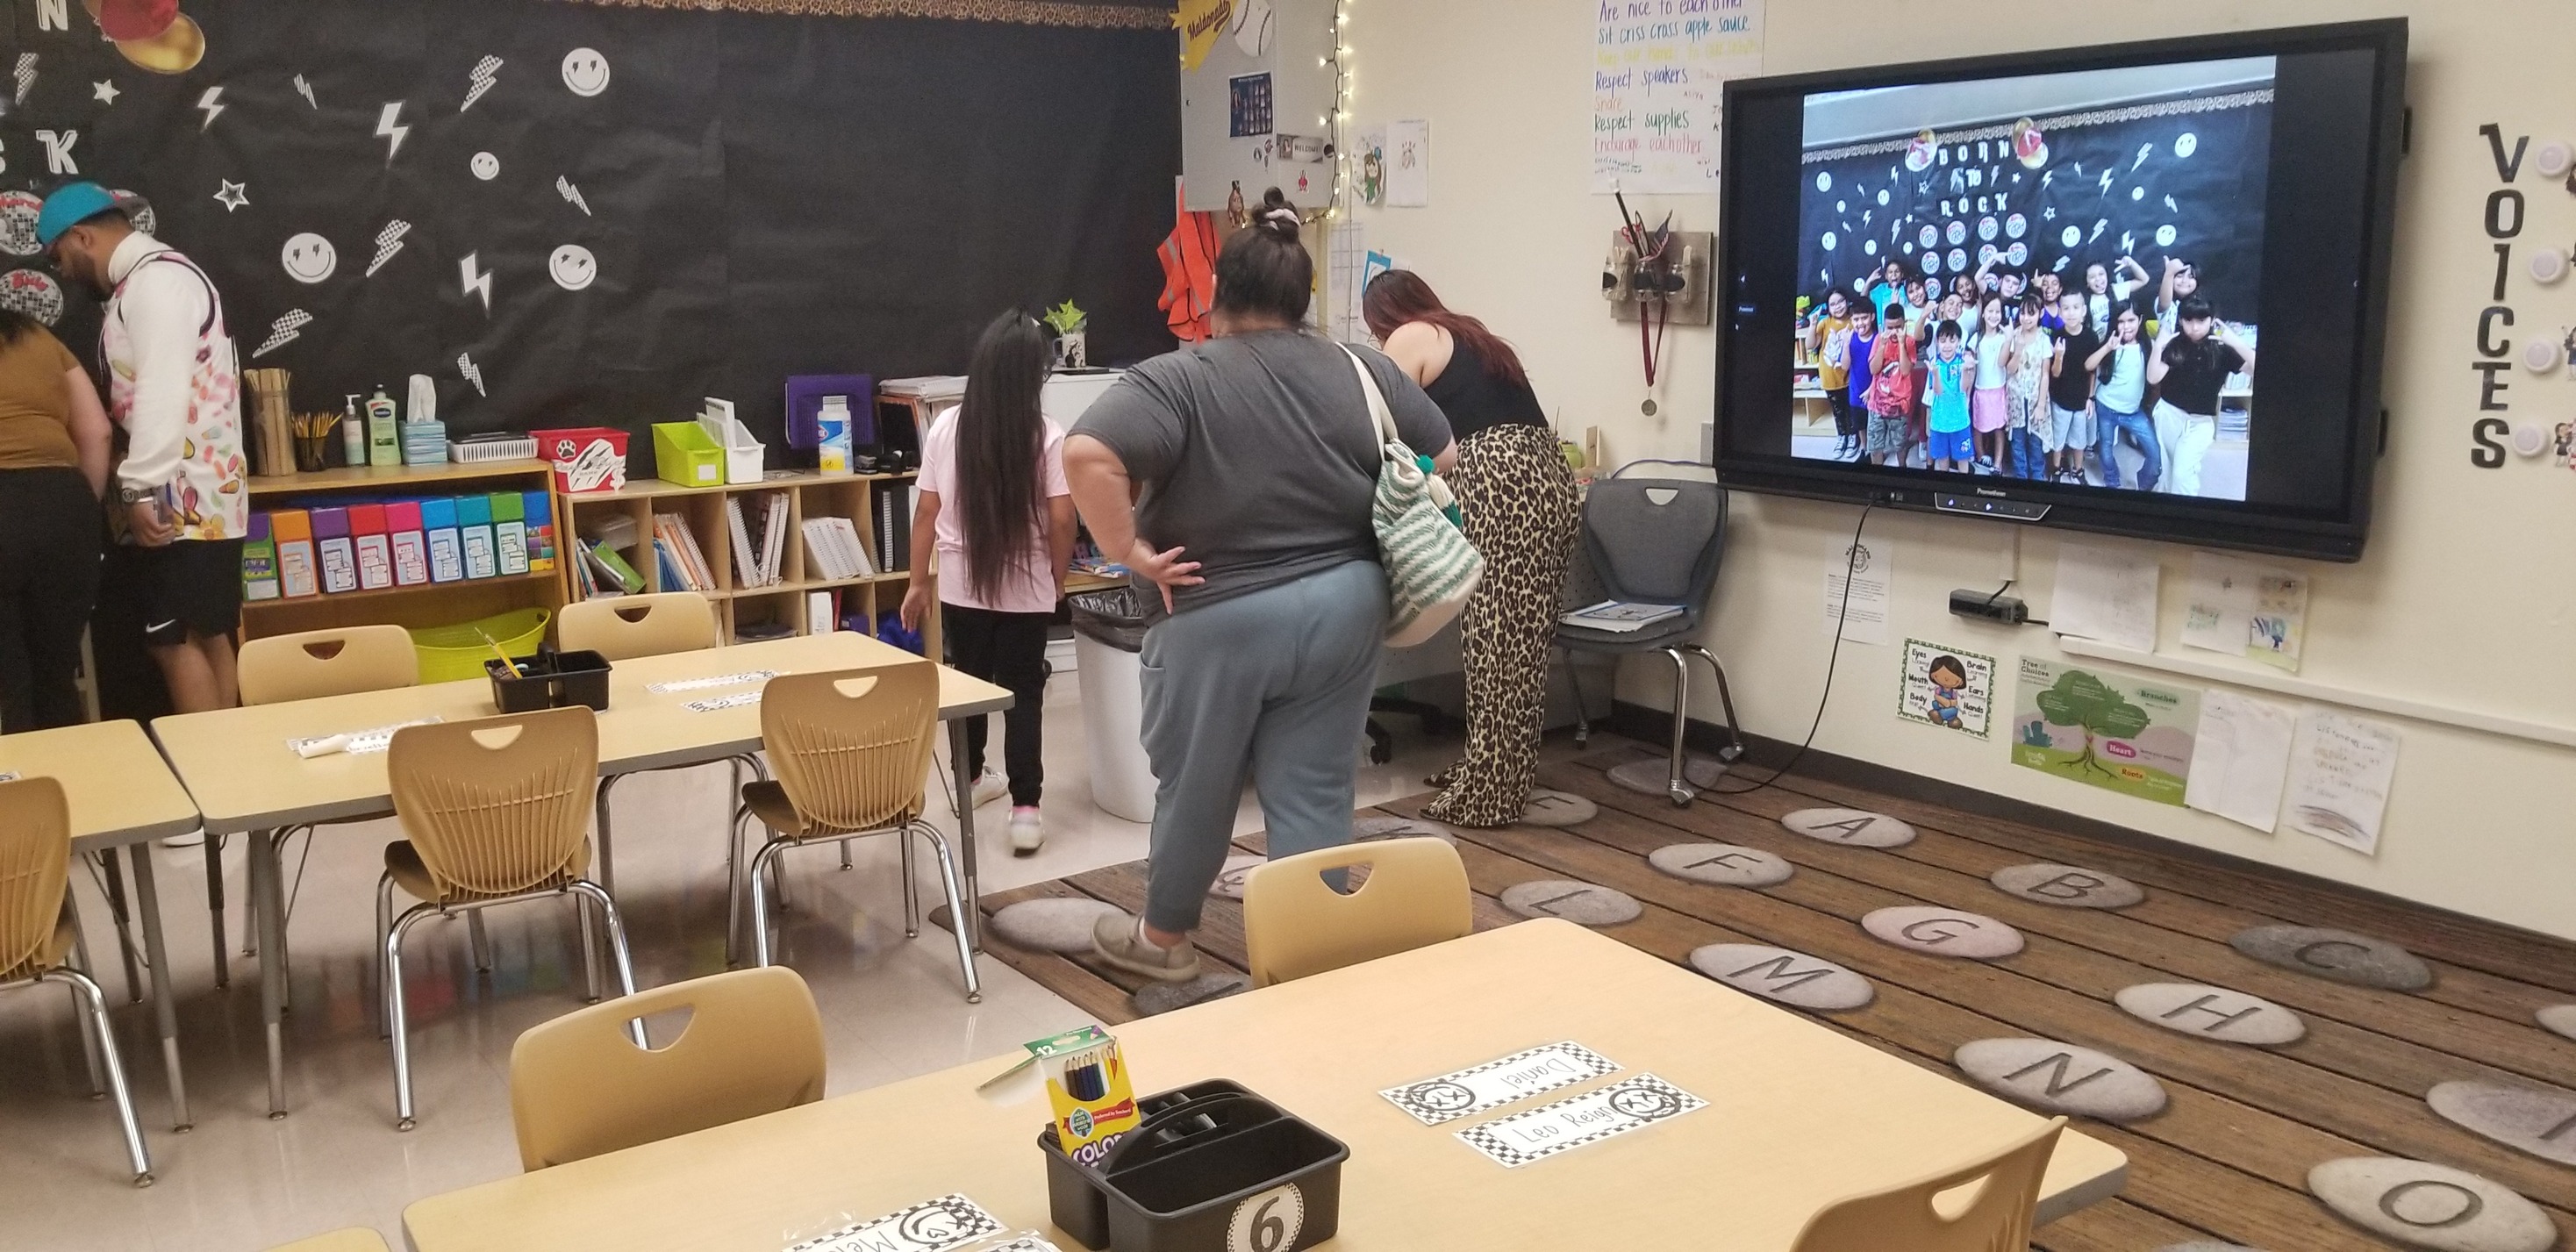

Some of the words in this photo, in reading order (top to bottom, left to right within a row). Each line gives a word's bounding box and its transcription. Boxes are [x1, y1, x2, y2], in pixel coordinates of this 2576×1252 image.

[1599, 1, 1619, 23] Are
[1628, 2, 1650, 18] nice
[1660, 0, 1672, 16] to
[1680, 0, 1707, 15] each
[1598, 25, 1613, 45] Sit
[1620, 25, 1645, 43] criss
[1650, 22, 1678, 39] cross
[1685, 17, 1712, 42] apple
[1718, 15, 1750, 33] sauce
[1595, 68, 1633, 98] Respect
[1642, 65, 1689, 97] speakers
[1595, 110, 1635, 140] Respect
[1645, 107, 1690, 137] supplies
[1965, 168, 1982, 187] TO
[1940, 192, 2008, 218] ROCK
[2472, 123, 2529, 469] VOICES
[1912, 648, 1927, 661] Eyes
[2021, 659, 2038, 669] Tree
[1967, 661, 1987, 671] Brain
[2021, 666, 2050, 677] Choices
[1908, 673, 1928, 684] Mouth
[1910, 692, 1927, 706] Body
[1969, 686, 1985, 696] Ears
[2141, 690, 2178, 704] Branches
[1964, 703, 1984, 713] Hands
[2109, 744, 2132, 756] Heart
[2122, 768, 2143, 780] Roots
[1807, 817, 1877, 839] A
[1682, 852, 1763, 870] F
[2027, 872, 2105, 899] B
[1528, 889, 1593, 916] L
[1901, 918, 1980, 945] G
[2294, 940, 2374, 969] C
[1727, 955, 1836, 994] M
[2160, 993, 2264, 1033] H
[1036, 1045, 1058, 1055] 12
[1500, 1058, 1577, 1090] Daniel
[2001, 1052, 2115, 1098] N
[1512, 1124, 1560, 1143] Leo
[2379, 1180, 2484, 1228] O
[1250, 1196, 1284, 1252] 6
